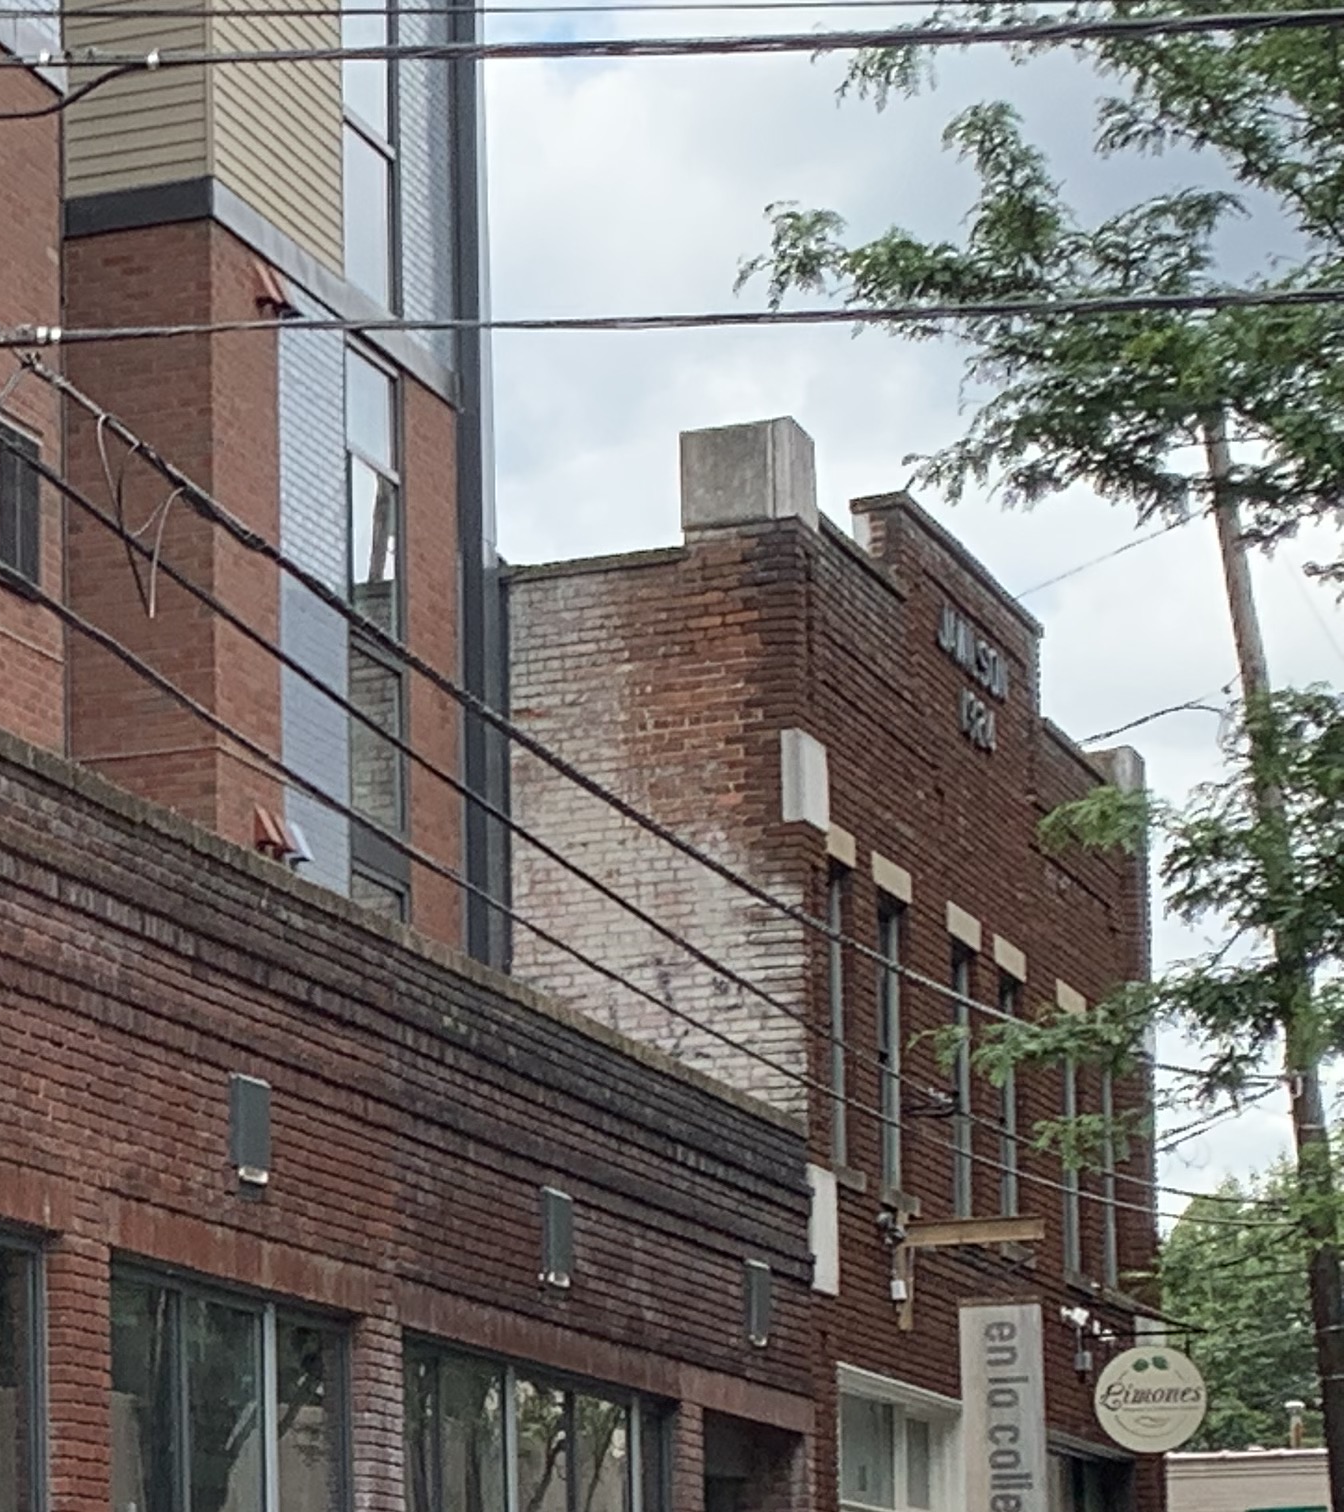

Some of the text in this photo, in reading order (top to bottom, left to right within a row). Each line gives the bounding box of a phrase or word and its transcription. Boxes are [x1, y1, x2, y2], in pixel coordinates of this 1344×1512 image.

[984, 1321, 1018, 1367] en
[987, 1375, 1029, 1408] la
[1099, 1382, 1204, 1411] Limones
